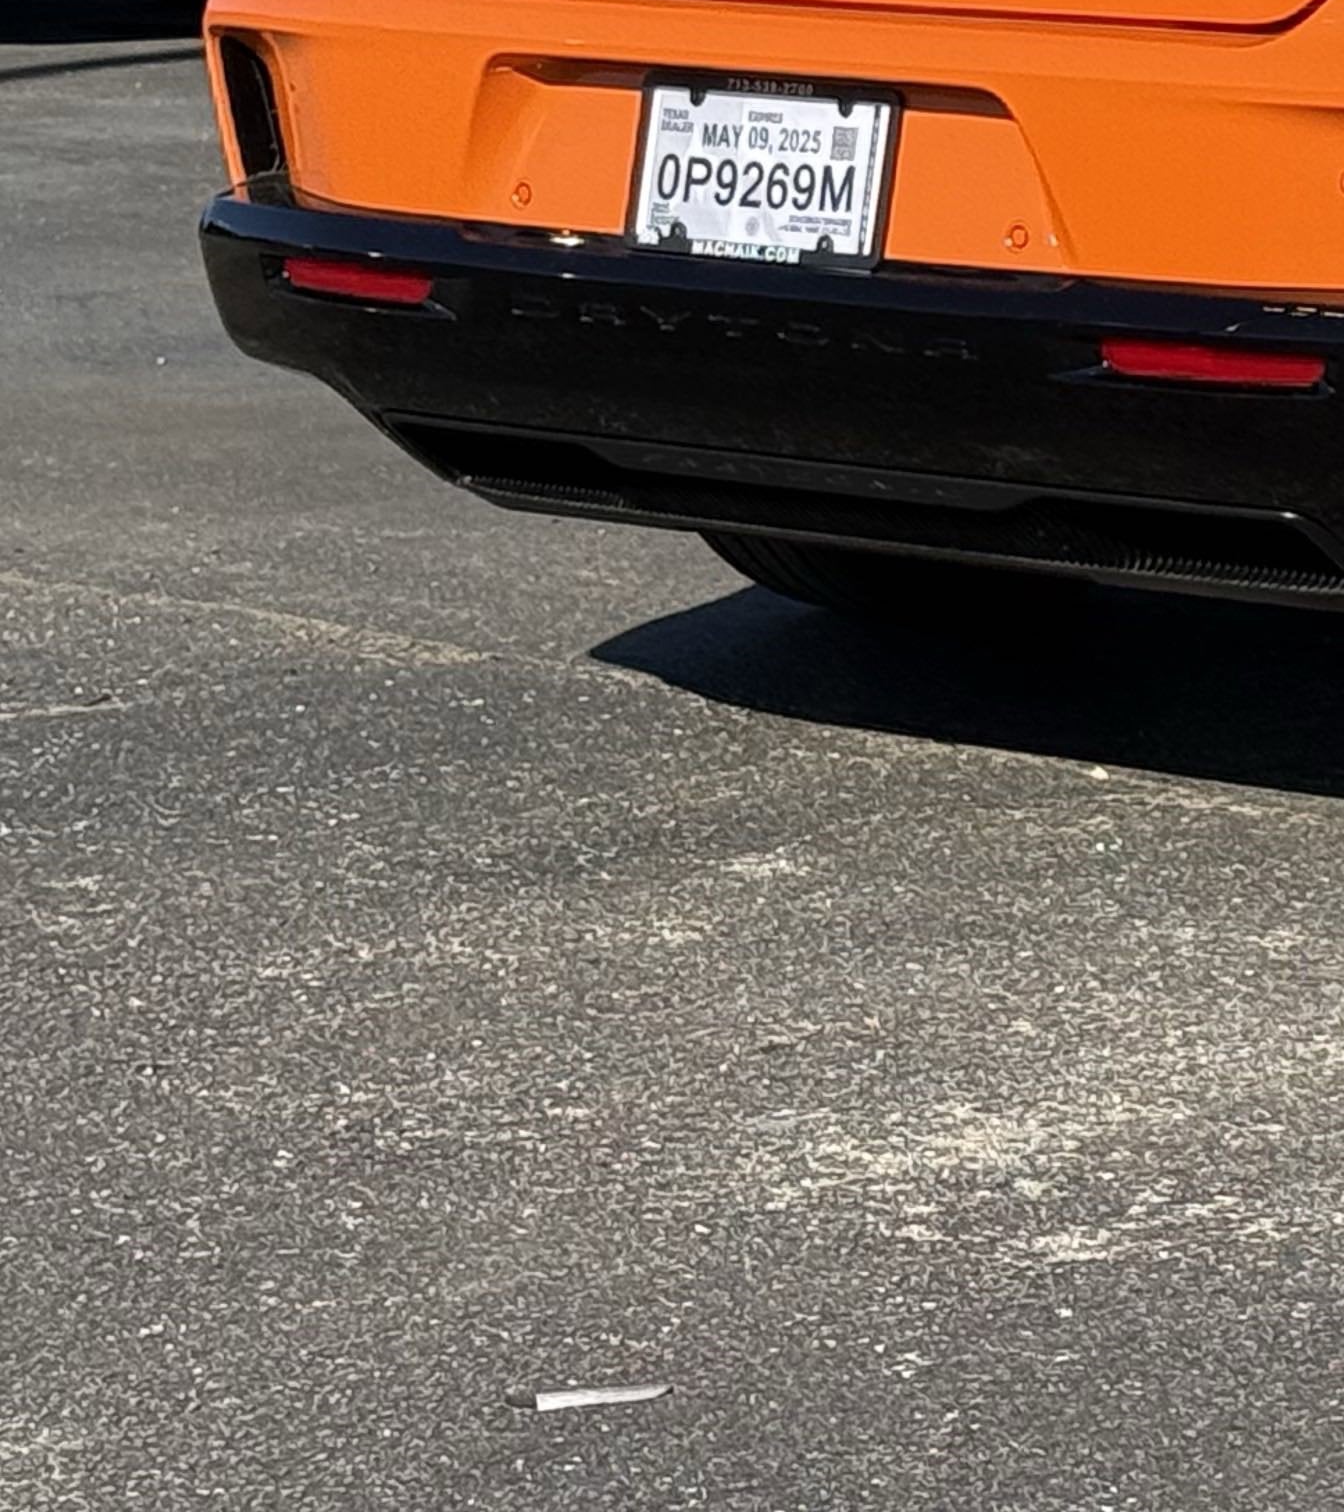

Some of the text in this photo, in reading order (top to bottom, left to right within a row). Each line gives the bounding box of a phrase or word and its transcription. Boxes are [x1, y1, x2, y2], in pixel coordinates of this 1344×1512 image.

[702, 122, 822, 155] MAY 09, 2025
